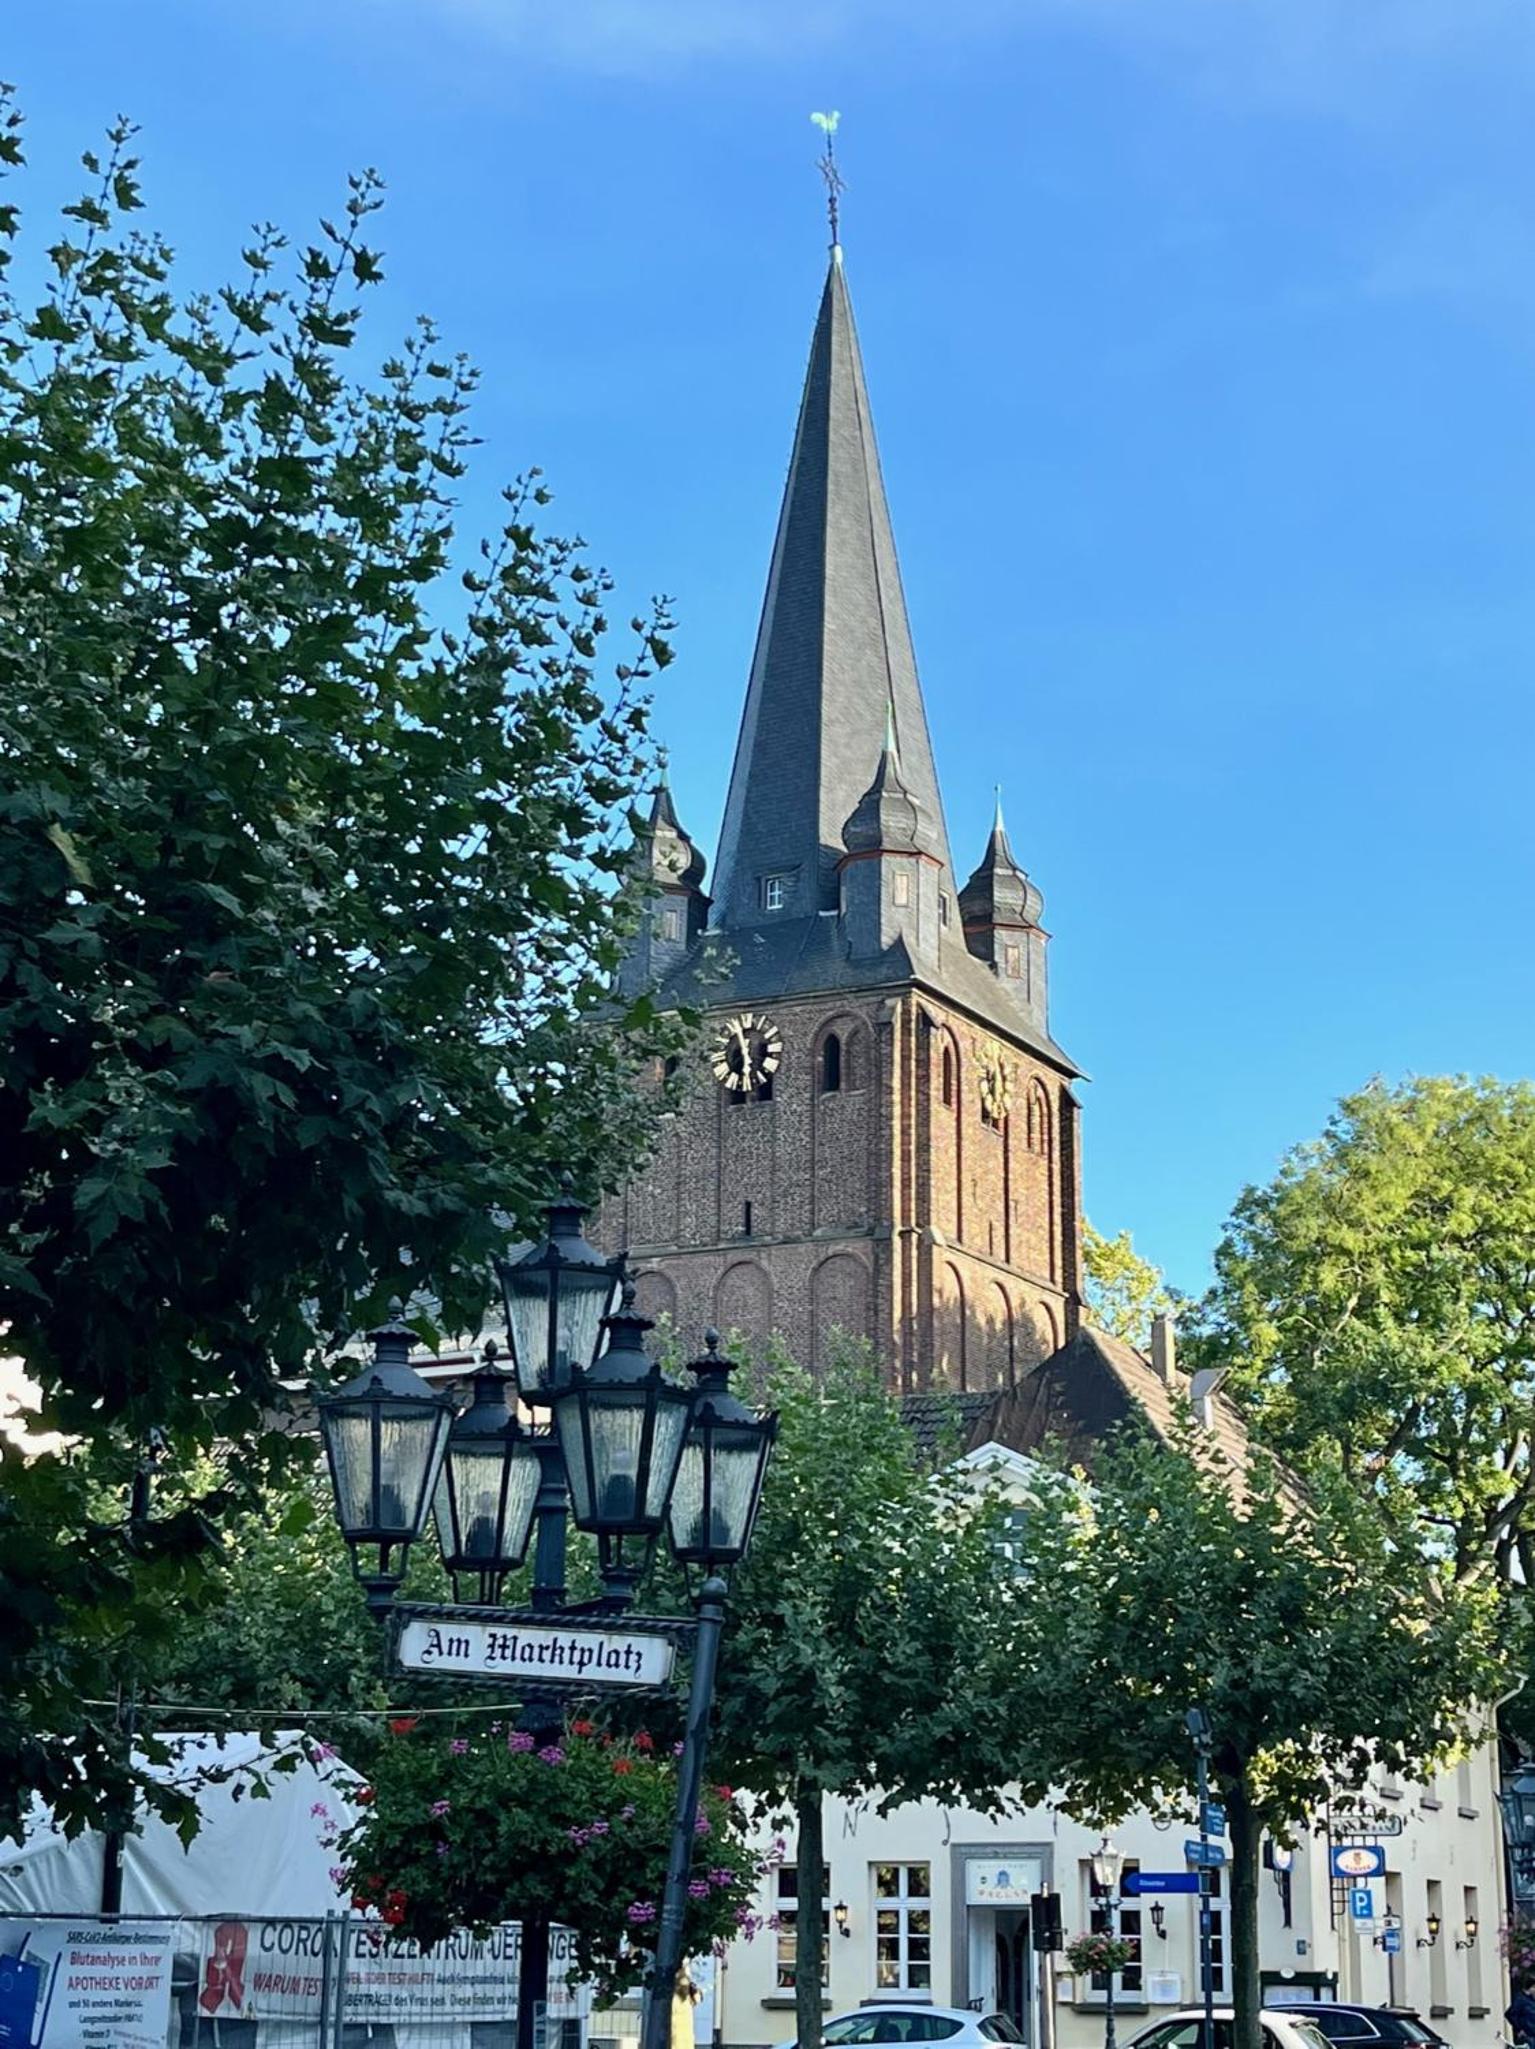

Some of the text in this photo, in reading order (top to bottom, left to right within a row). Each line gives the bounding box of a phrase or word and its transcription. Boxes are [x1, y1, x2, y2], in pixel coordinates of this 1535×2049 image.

[420, 1628, 643, 1680] Am Marktplatz
[1354, 1892, 1368, 1915] P
[70, 1951, 126, 1969] Blutanalyse
[128, 1952, 138, 1966] in
[67, 1975, 121, 1991] APOTHEKE
[253, 1972, 301, 1995] WARUM
